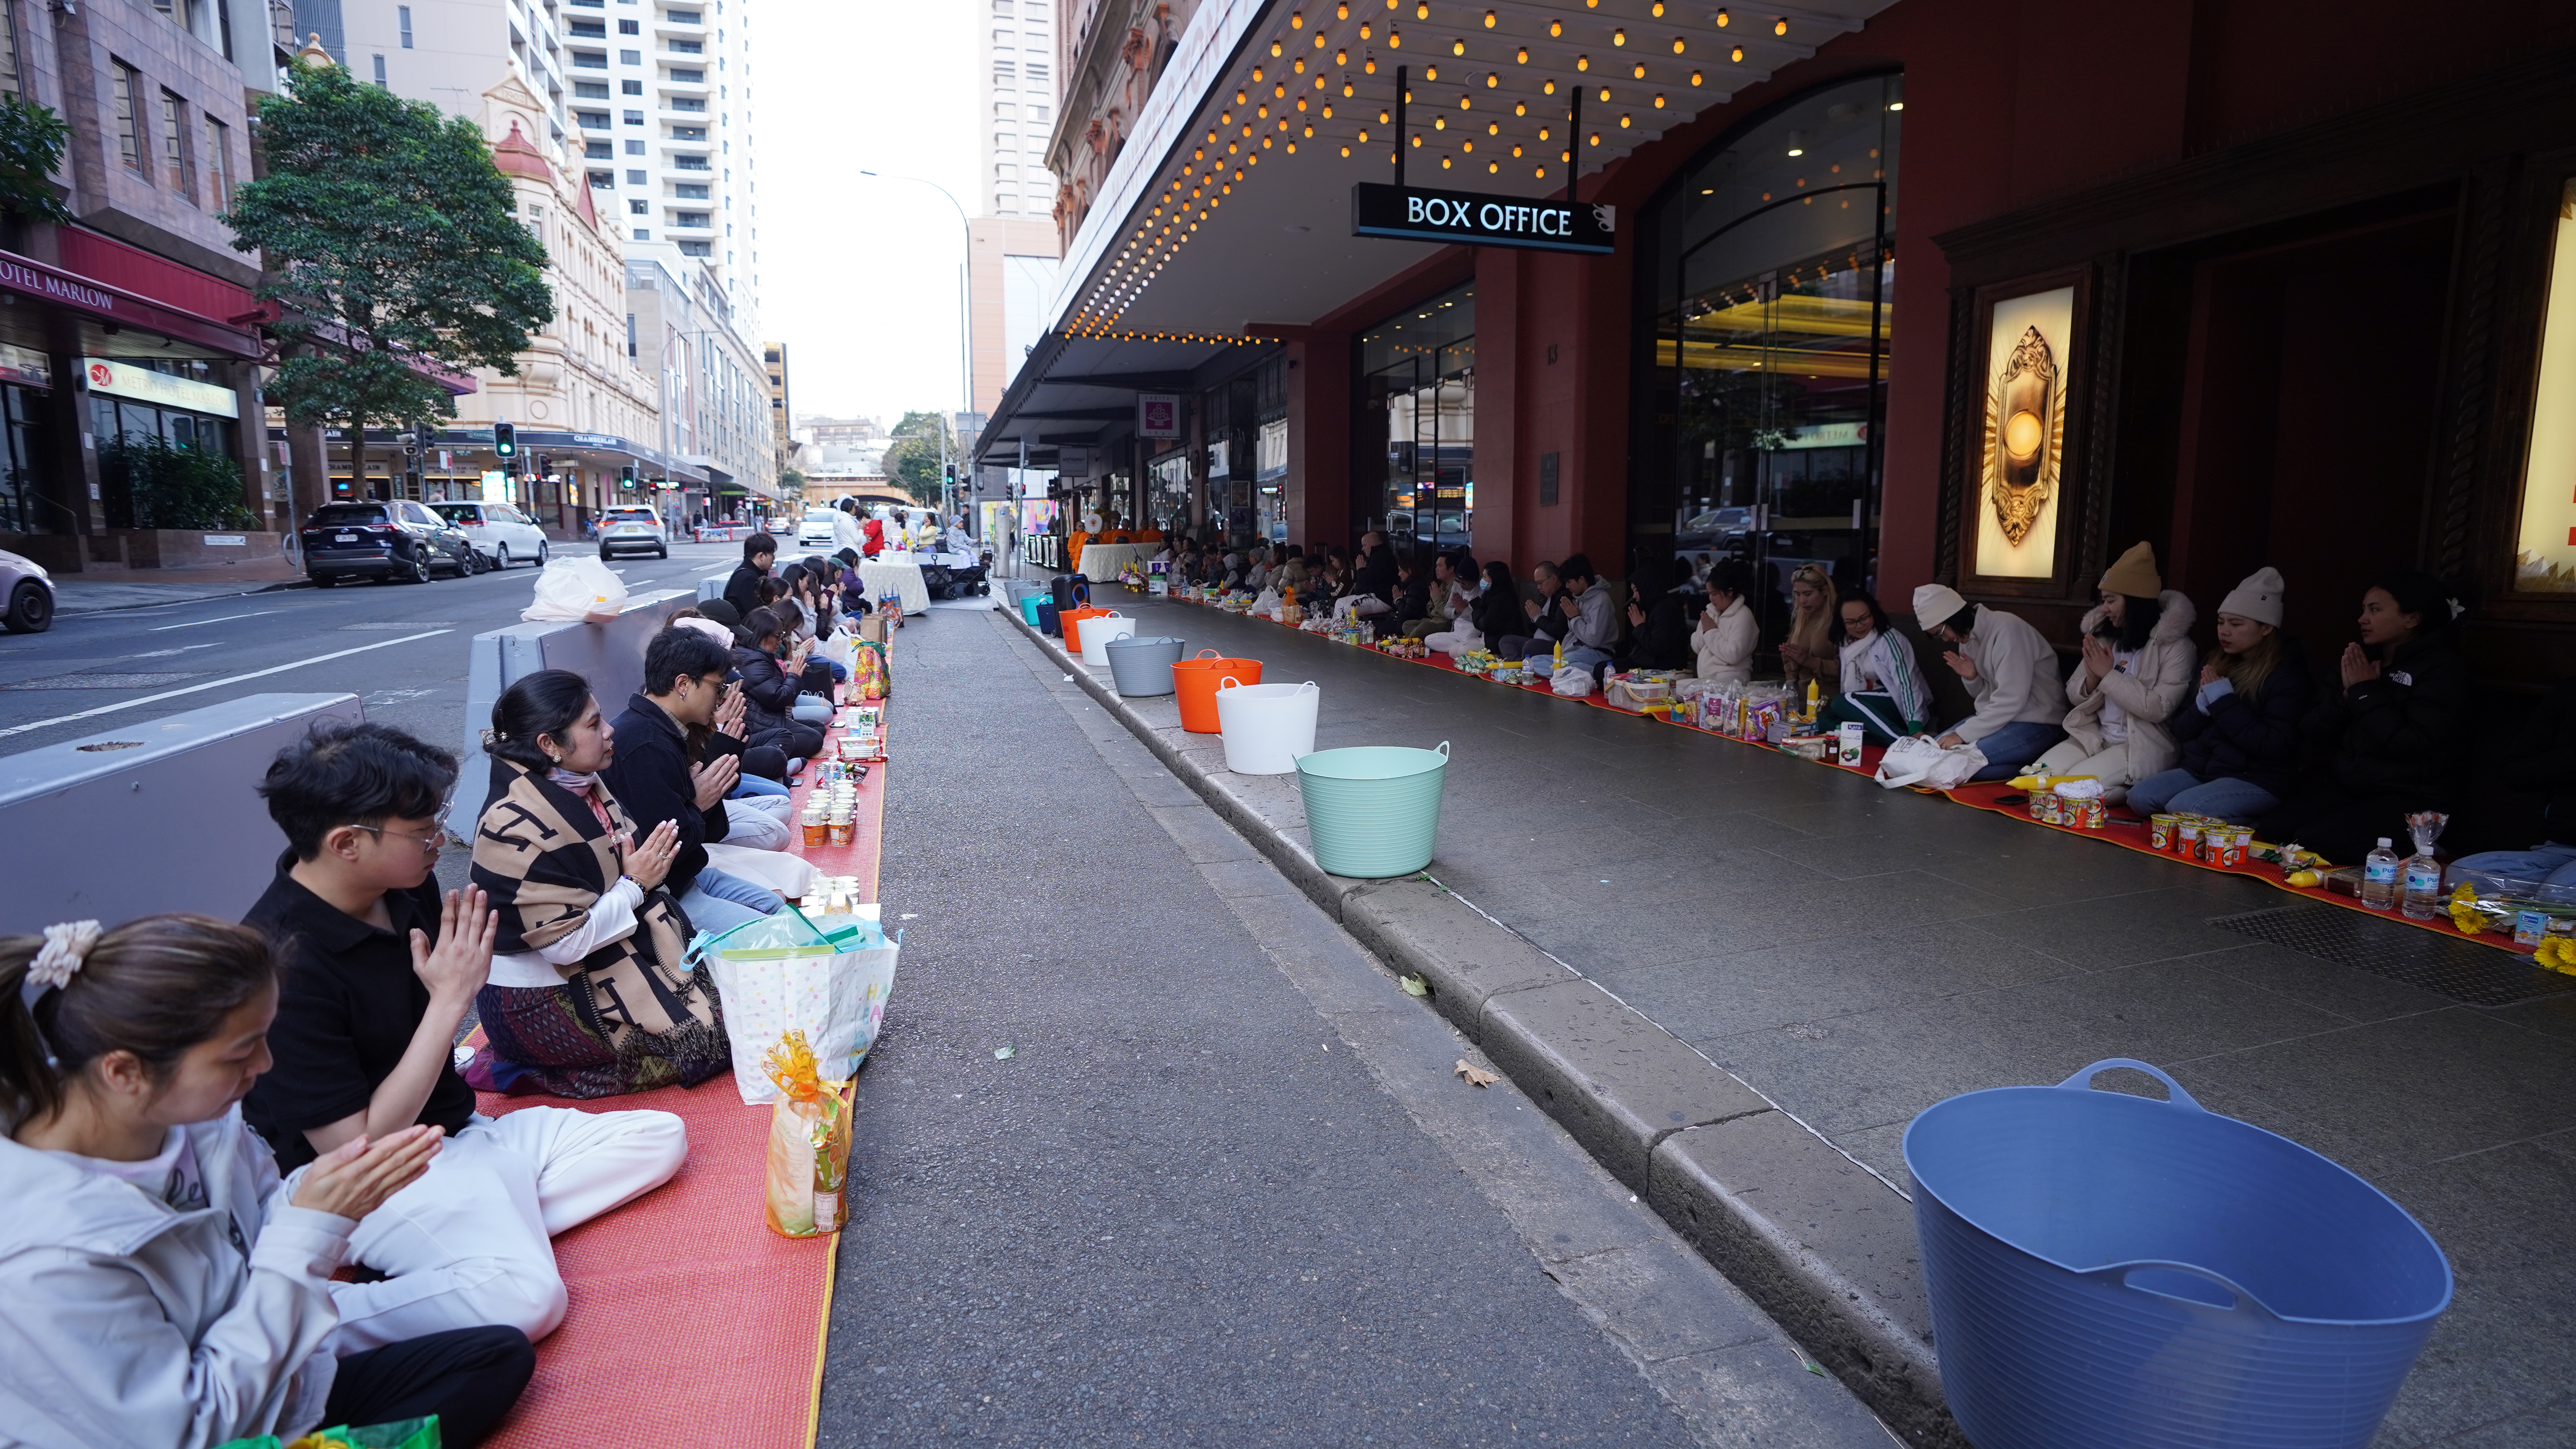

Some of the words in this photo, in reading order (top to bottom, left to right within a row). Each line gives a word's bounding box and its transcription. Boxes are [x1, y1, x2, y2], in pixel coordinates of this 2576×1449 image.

[1408, 197, 1471, 227] BOX
[1480, 203, 1572, 236] OFFICE
[46, 275, 113, 310] MARLOW
[1547, 344, 1558, 365] 13
[122, 376, 158, 393] METRO
[160, 382, 191, 400] HOTEL
[192, 391, 230, 408] MARLOW
[574, 435, 617, 445] CHAMBERLAIN
